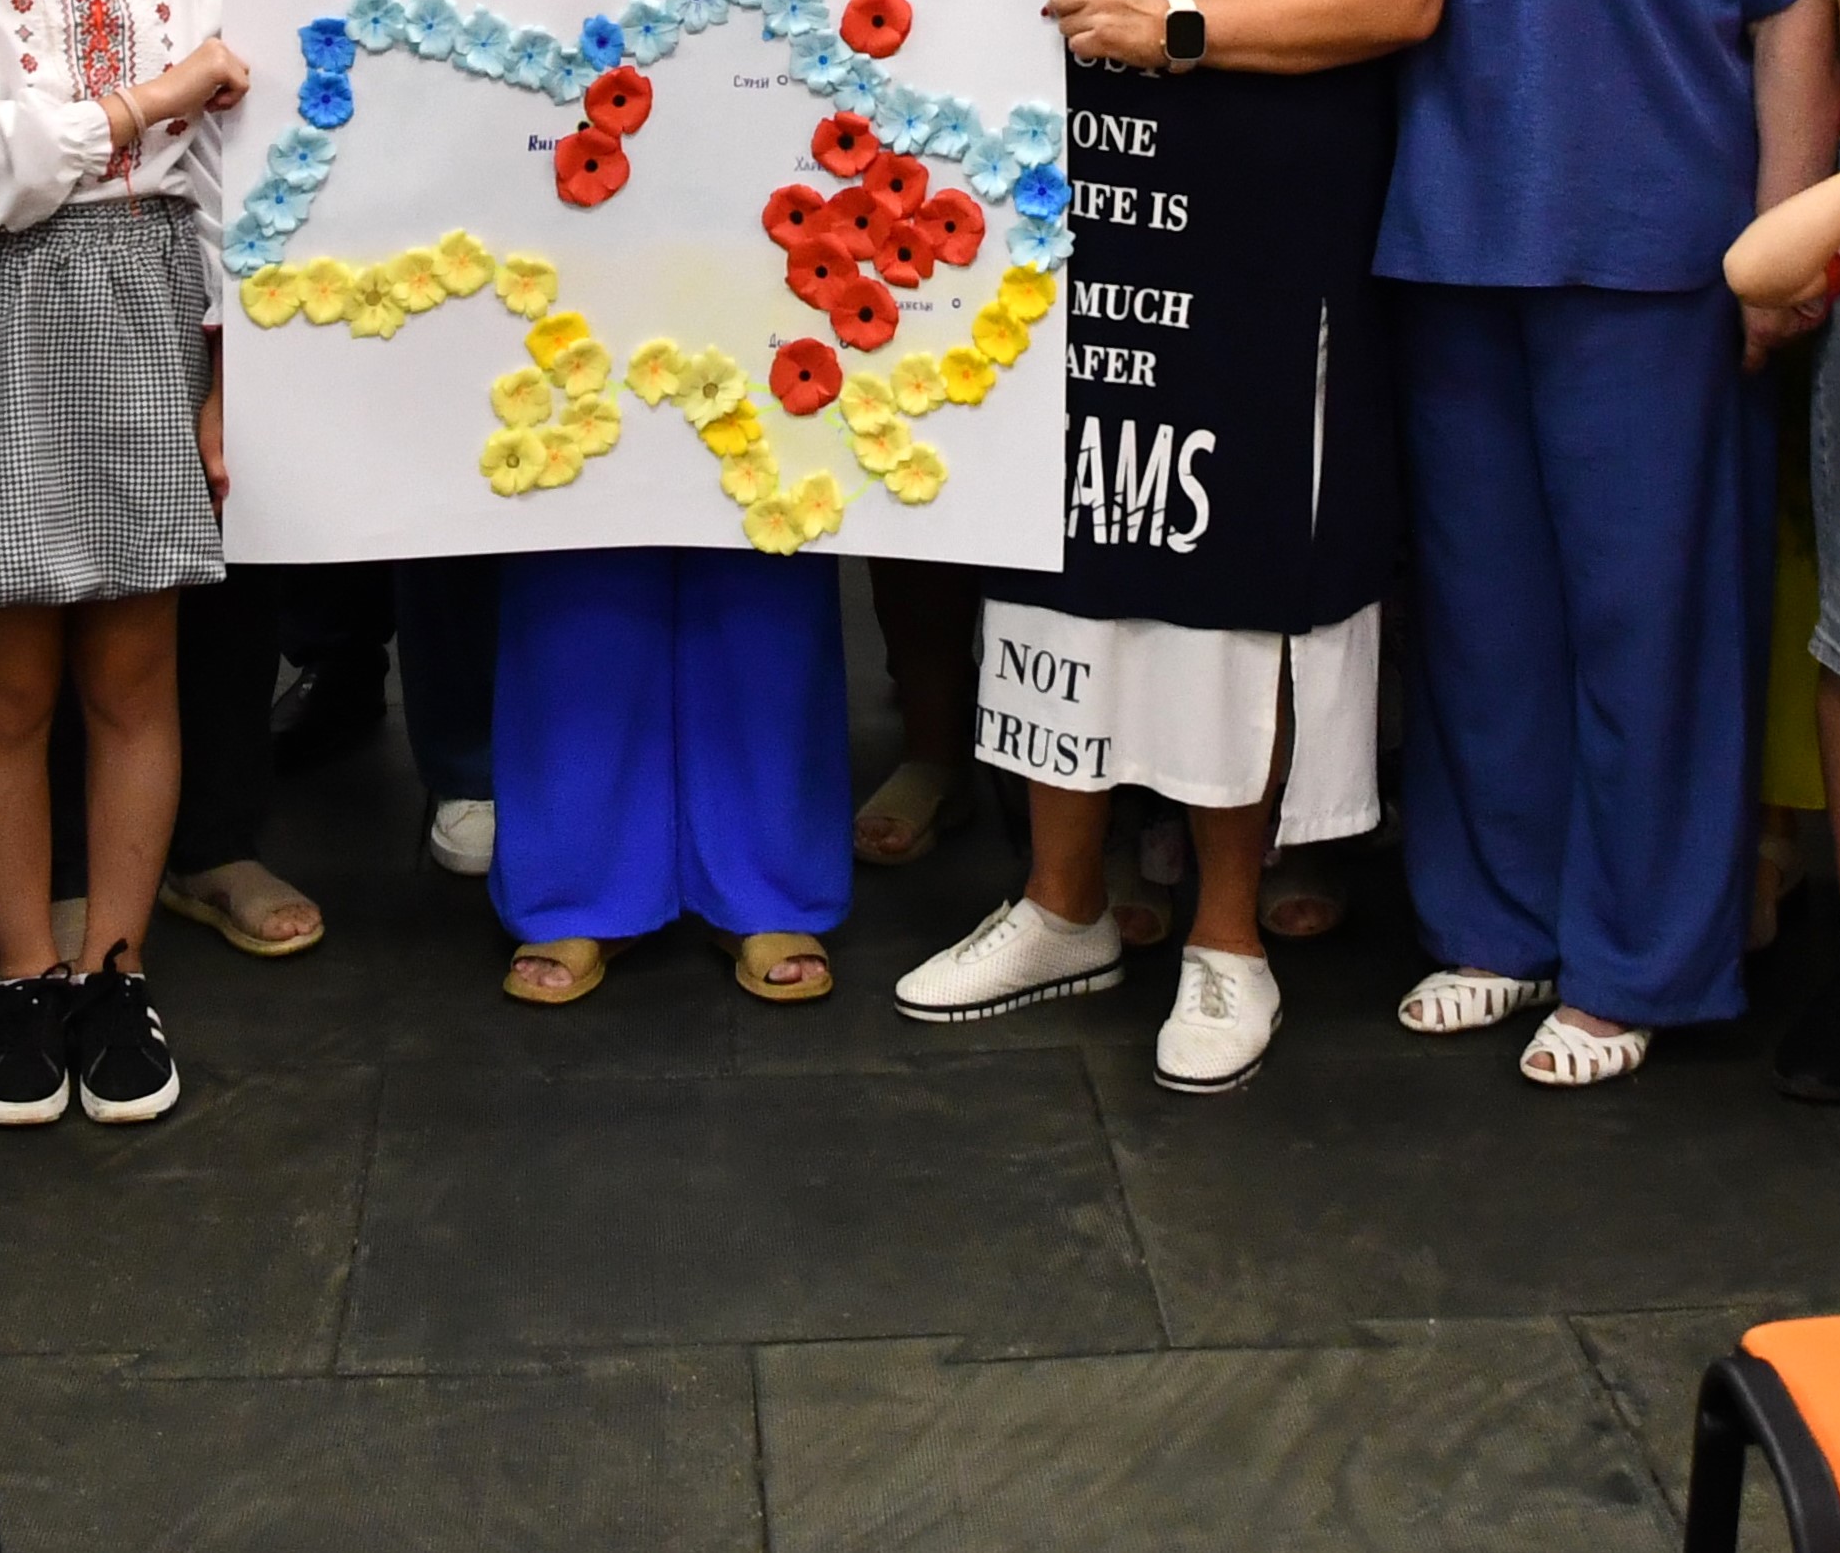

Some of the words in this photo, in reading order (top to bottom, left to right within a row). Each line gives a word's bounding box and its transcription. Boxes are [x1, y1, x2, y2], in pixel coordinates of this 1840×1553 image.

[1067, 108, 1157, 157] ONE
[1071, 179, 1138, 225] IFE
[1148, 192, 1188, 232] IS
[1071, 280, 1193, 329] MUCH
[1066, 343, 1156, 387] AFER
[1065, 413, 1216, 553] AMS
[995, 637, 1091, 703] NOT
[975, 706, 1111, 778] TRUST
